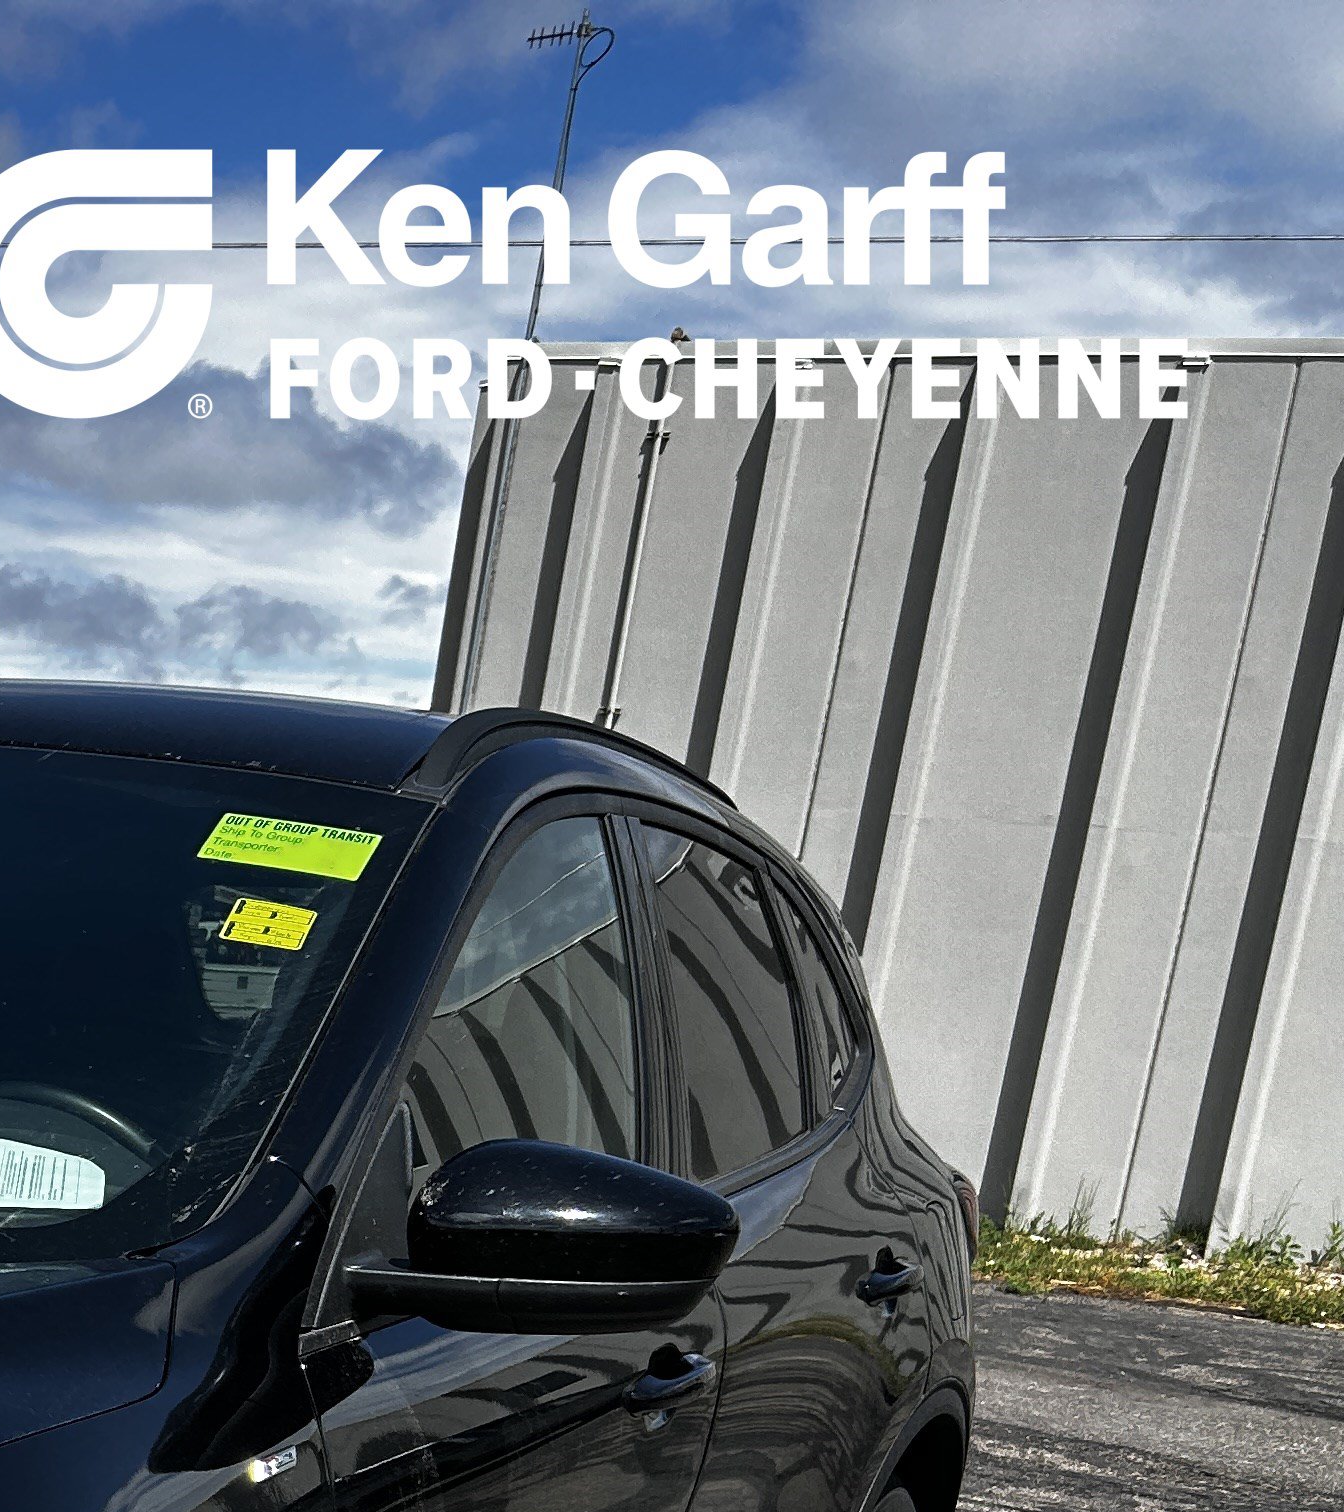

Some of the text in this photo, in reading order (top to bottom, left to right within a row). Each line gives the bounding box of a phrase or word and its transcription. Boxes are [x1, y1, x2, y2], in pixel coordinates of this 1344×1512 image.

[219, 825, 246, 838] Ship
[250, 829, 263, 839] To
[225, 815, 376, 844] OUT OF GROUP TRANSIT
